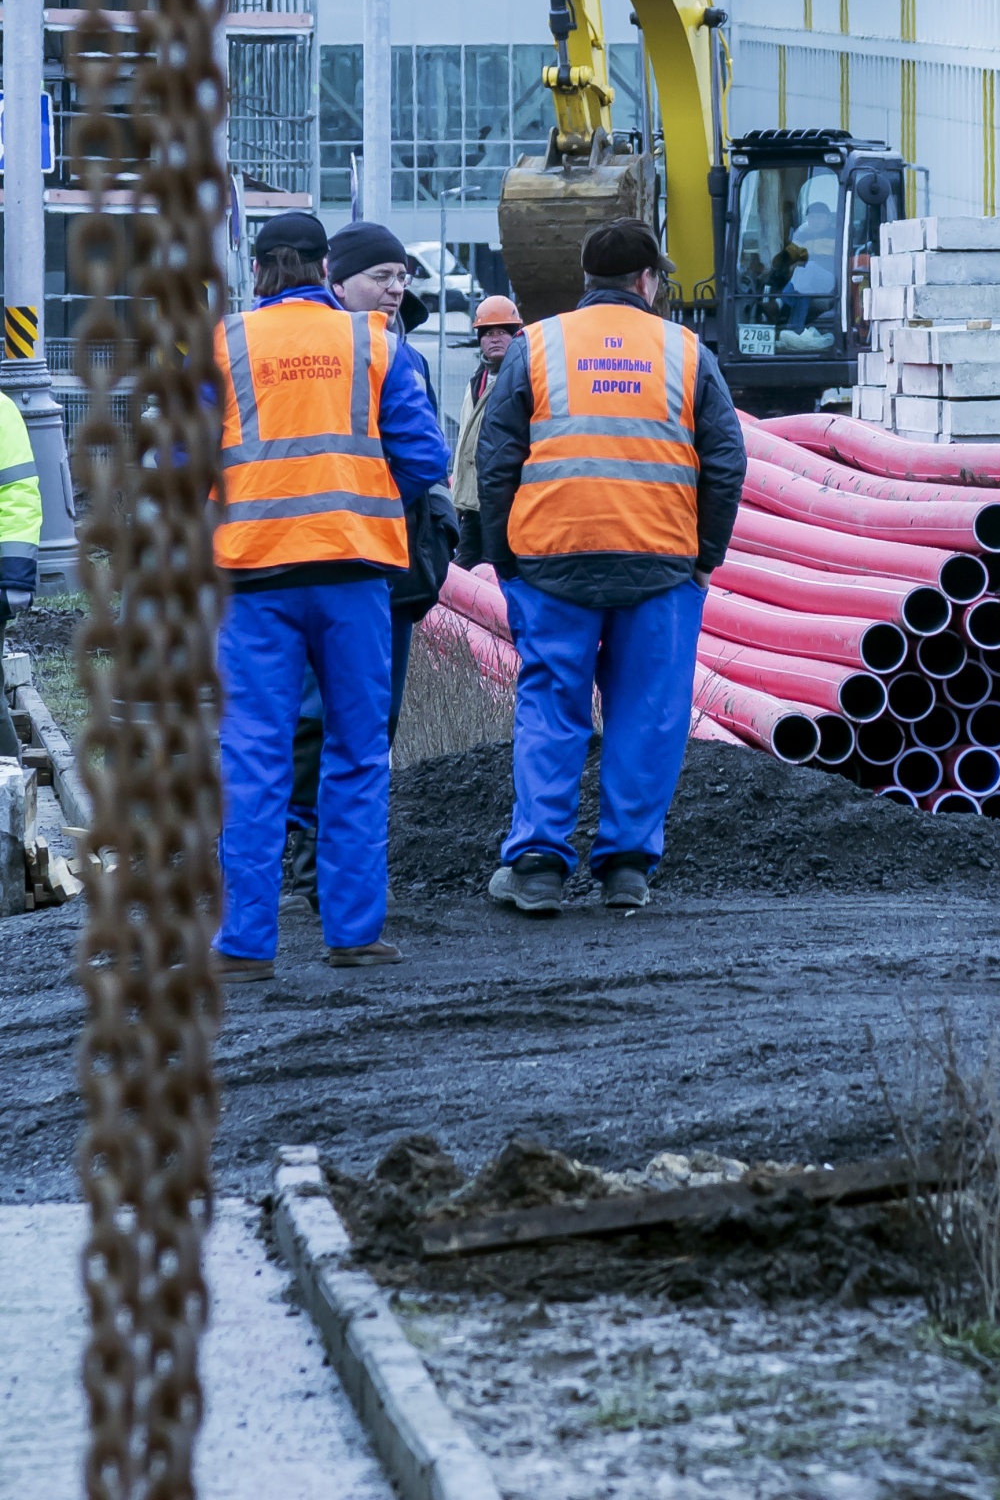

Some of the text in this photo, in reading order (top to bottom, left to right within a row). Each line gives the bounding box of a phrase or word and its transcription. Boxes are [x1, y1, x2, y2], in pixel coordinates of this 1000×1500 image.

[605, 337, 623, 348] ГБУ
[761, 345, 772, 353] 77
[279, 356, 341, 369] МОСКВА
[577, 358, 652, 373] АВТОМОБИЛЬНЫЕ
[281, 368, 342, 381] АВТОДОР
[592, 380, 641, 393] ДОРОГИ
